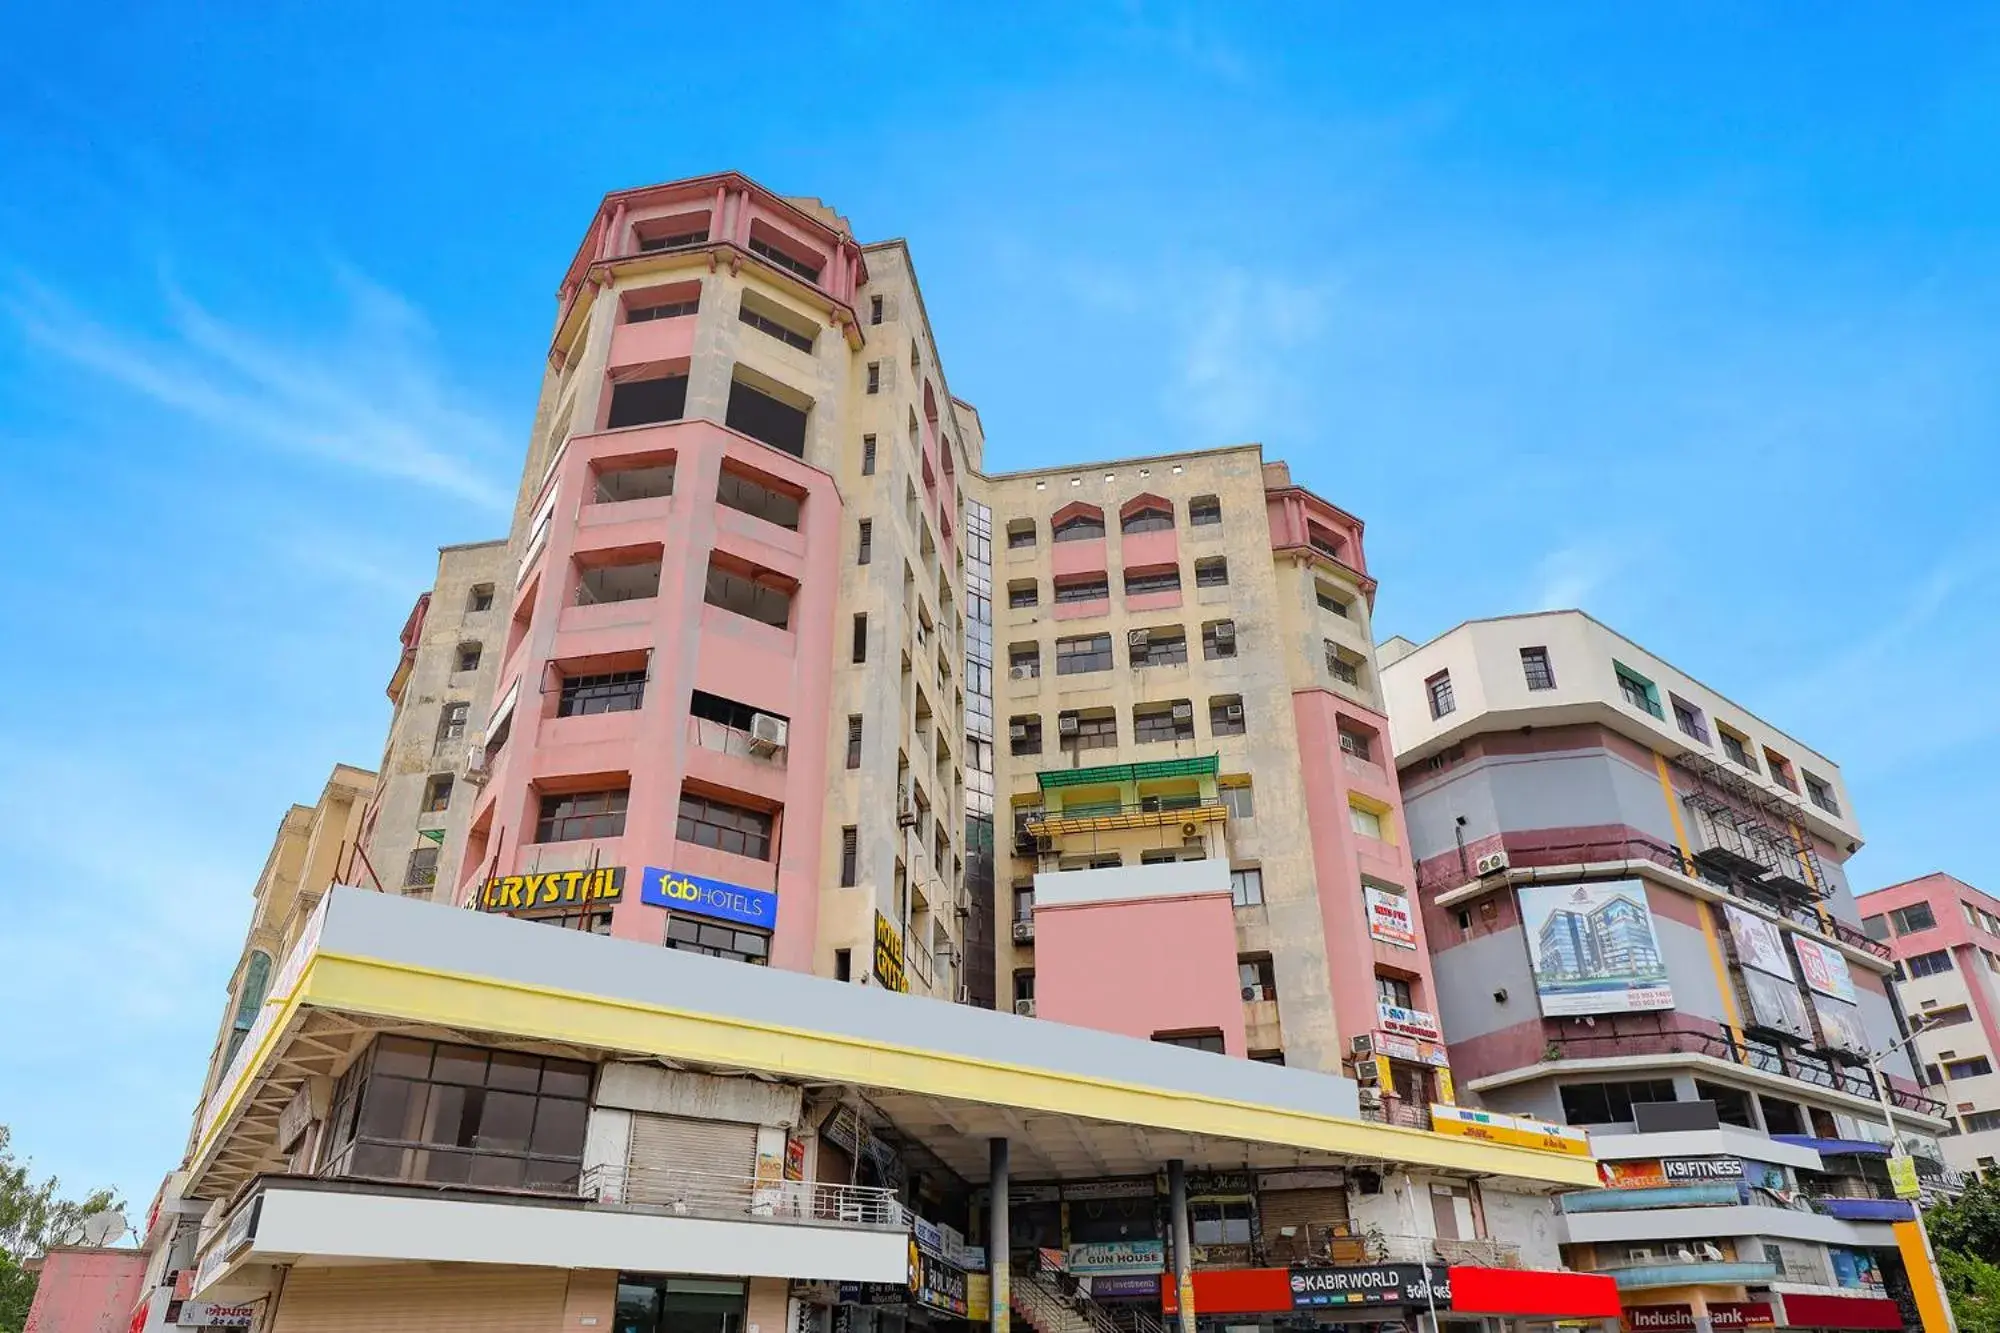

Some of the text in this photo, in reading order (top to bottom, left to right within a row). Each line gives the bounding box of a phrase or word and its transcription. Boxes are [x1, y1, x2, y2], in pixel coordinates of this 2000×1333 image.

[1087, 1252, 1158, 1265] GUN HOUSE
[1306, 1271, 1398, 1291] KABIR WORLD
